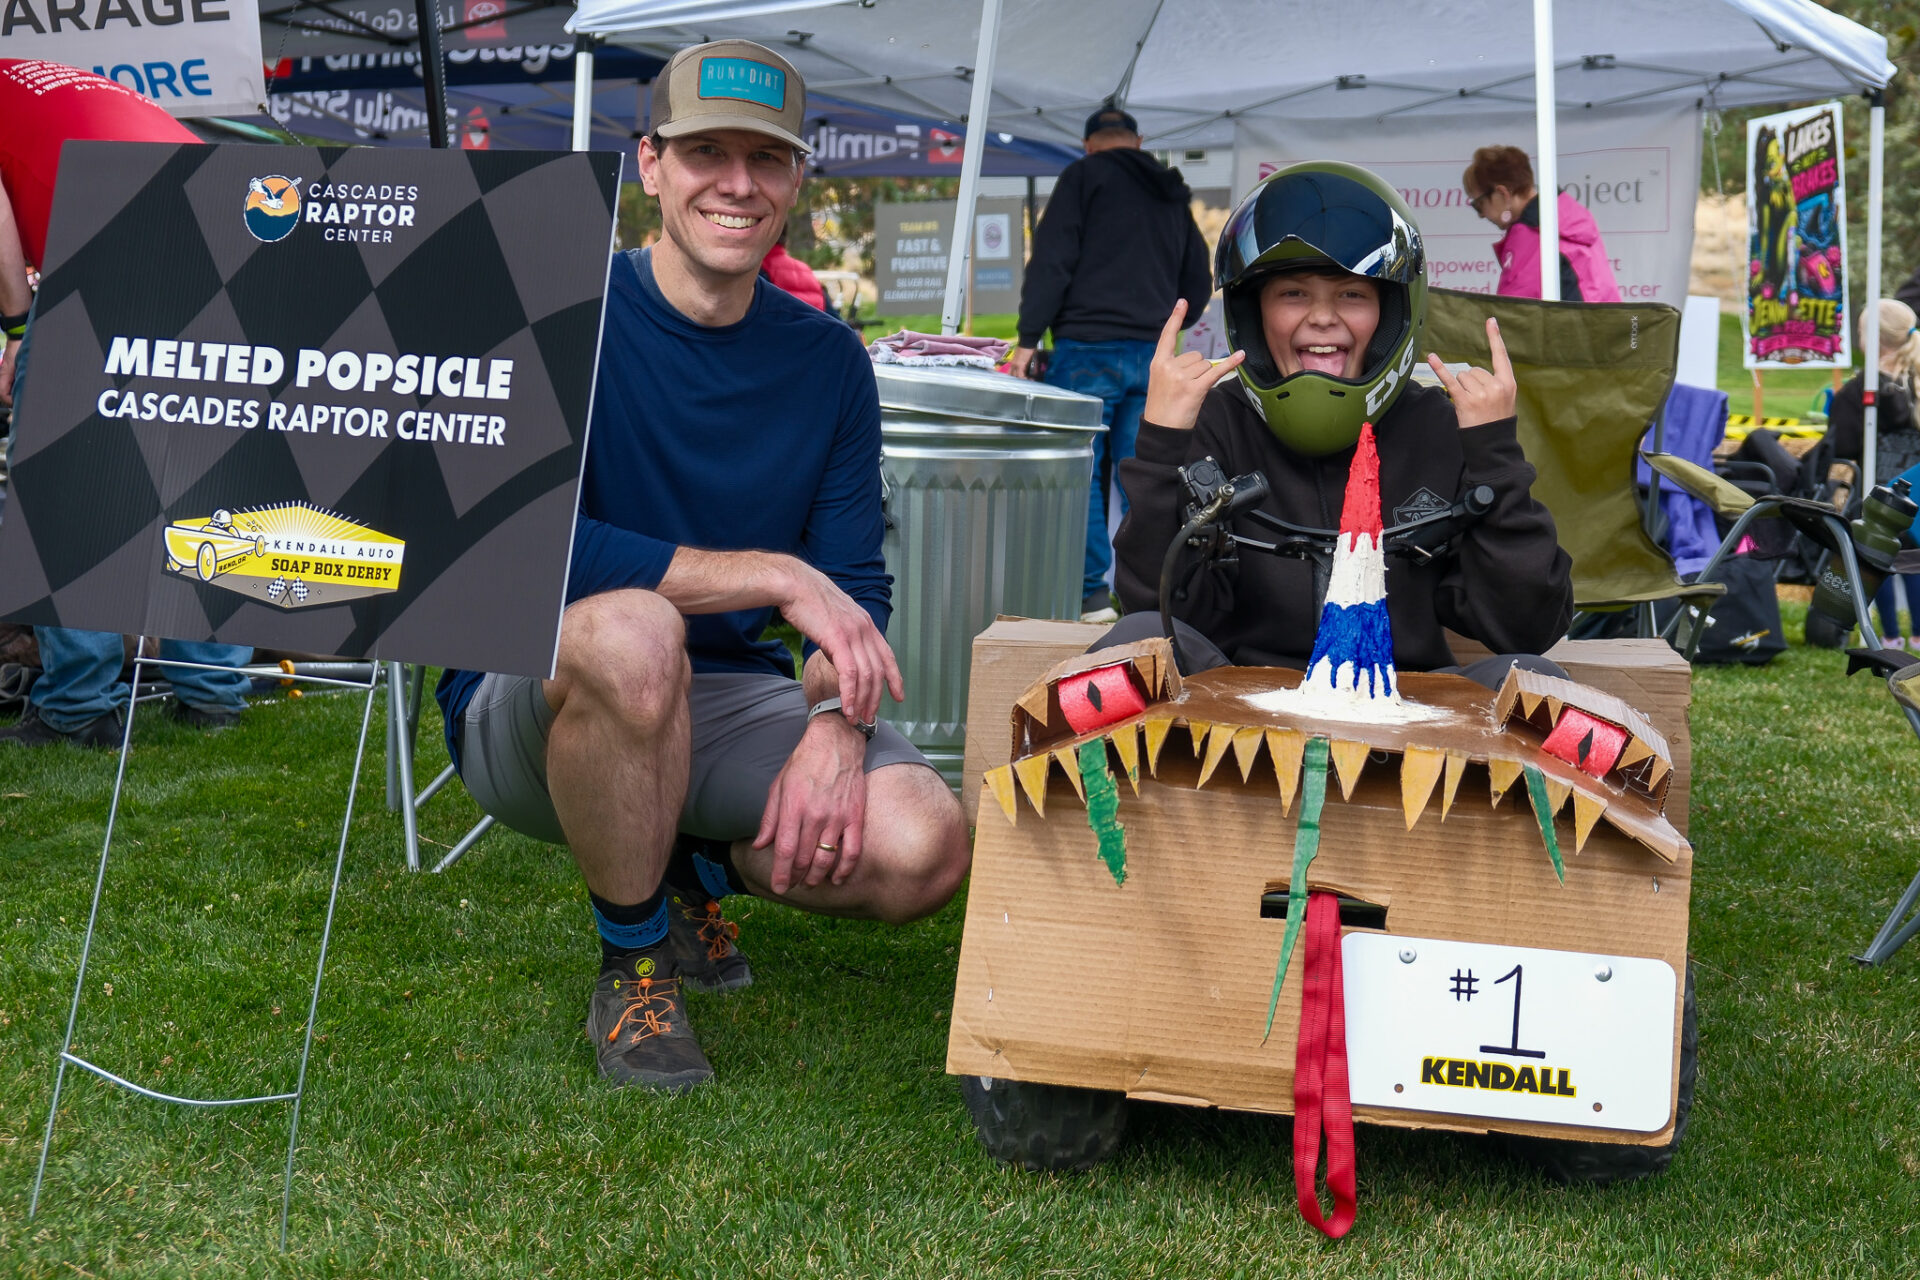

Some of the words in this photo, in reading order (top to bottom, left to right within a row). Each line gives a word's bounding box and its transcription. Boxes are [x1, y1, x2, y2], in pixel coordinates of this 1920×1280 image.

[92, 59, 212, 99] ORE
[707, 64, 735, 81] RUN
[749, 67, 779, 91] DIRT
[309, 183, 418, 201] CASCADES
[306, 201, 415, 227] RAPTOR
[324, 228, 393, 243] CENTER
[896, 239, 928, 254] FAST
[890, 256, 947, 273] FUGITIVE
[1622, 284, 1661, 298] ncer
[104, 336, 285, 386] MELTED
[296, 348, 514, 400] POPSICLE
[97, 388, 260, 430] CASCADES
[267, 401, 388, 438] RAPTOR
[396, 410, 506, 446] CENTER
[273, 540, 345, 555] KENDALL
[357, 547, 394, 559] AUTO
[271, 558, 310, 573] SOAP
[313, 562, 344, 577] BOX
[346, 564, 392, 581] DERBY
[1449, 964, 1546, 1059] #1
[1420, 1056, 1577, 1098] KENDALL
